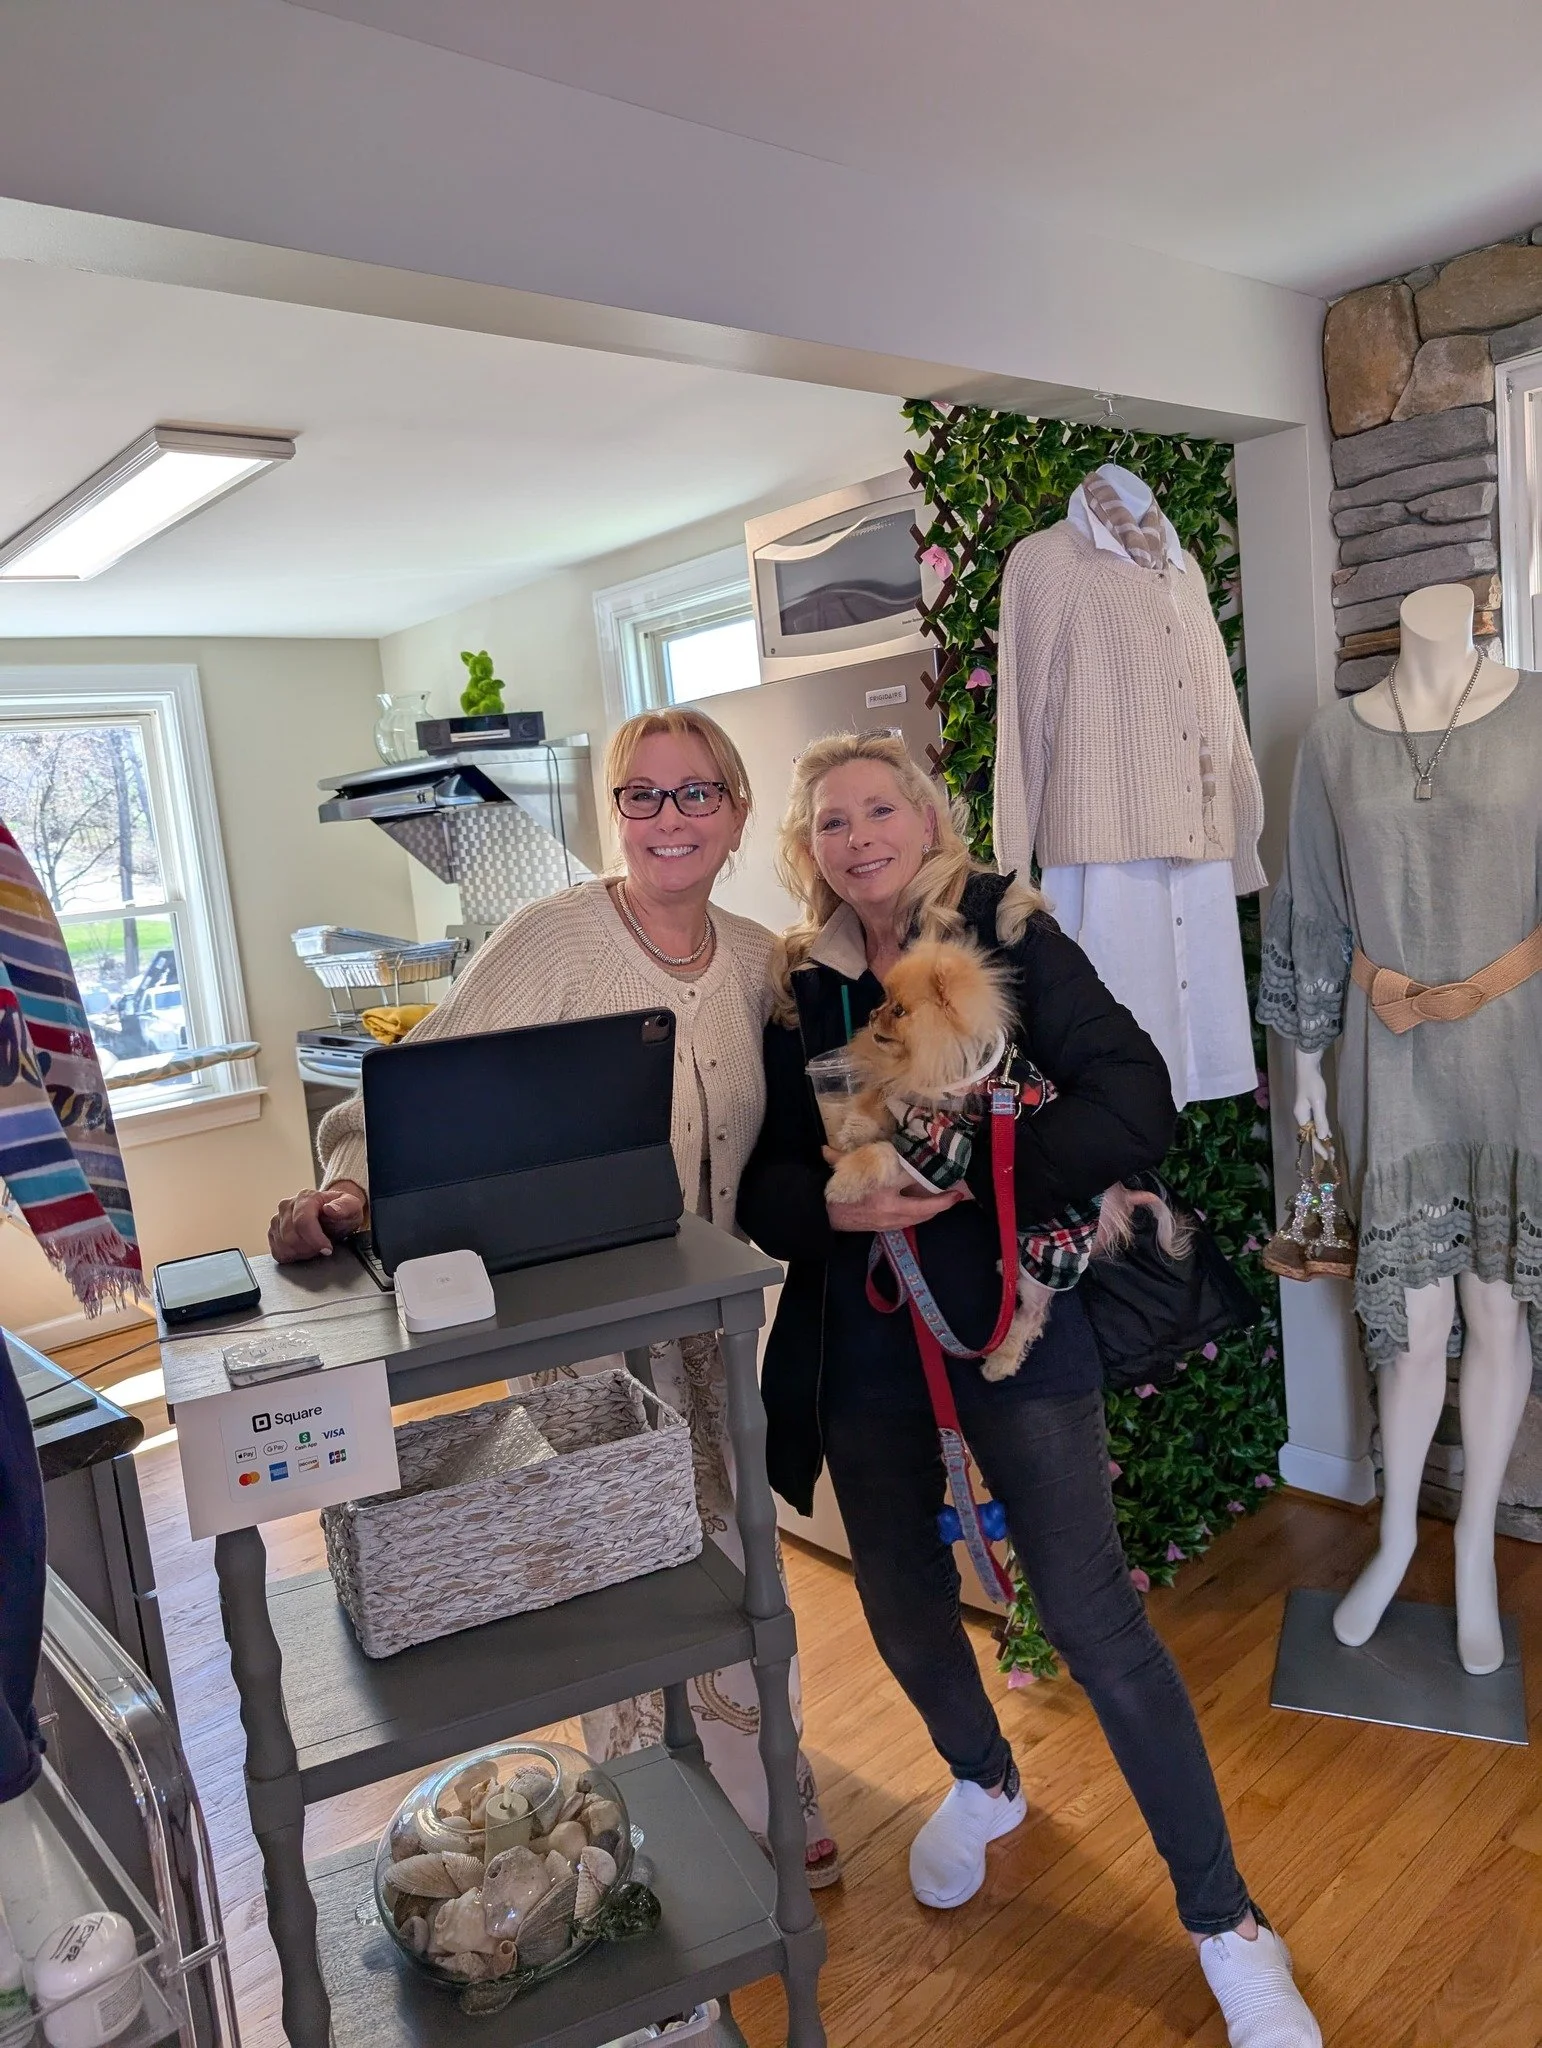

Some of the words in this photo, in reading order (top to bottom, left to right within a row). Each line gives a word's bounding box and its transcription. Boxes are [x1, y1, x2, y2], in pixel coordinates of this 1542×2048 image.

[869, 691, 902, 702] FRIGIDAIRE
[274, 1406, 323, 1425] Square
[322, 1427, 346, 1440] VISA
[273, 1444, 285, 1452] Pay
[243, 1451, 254, 1459] Pay
[60, 1916, 104, 1964] TESTER
